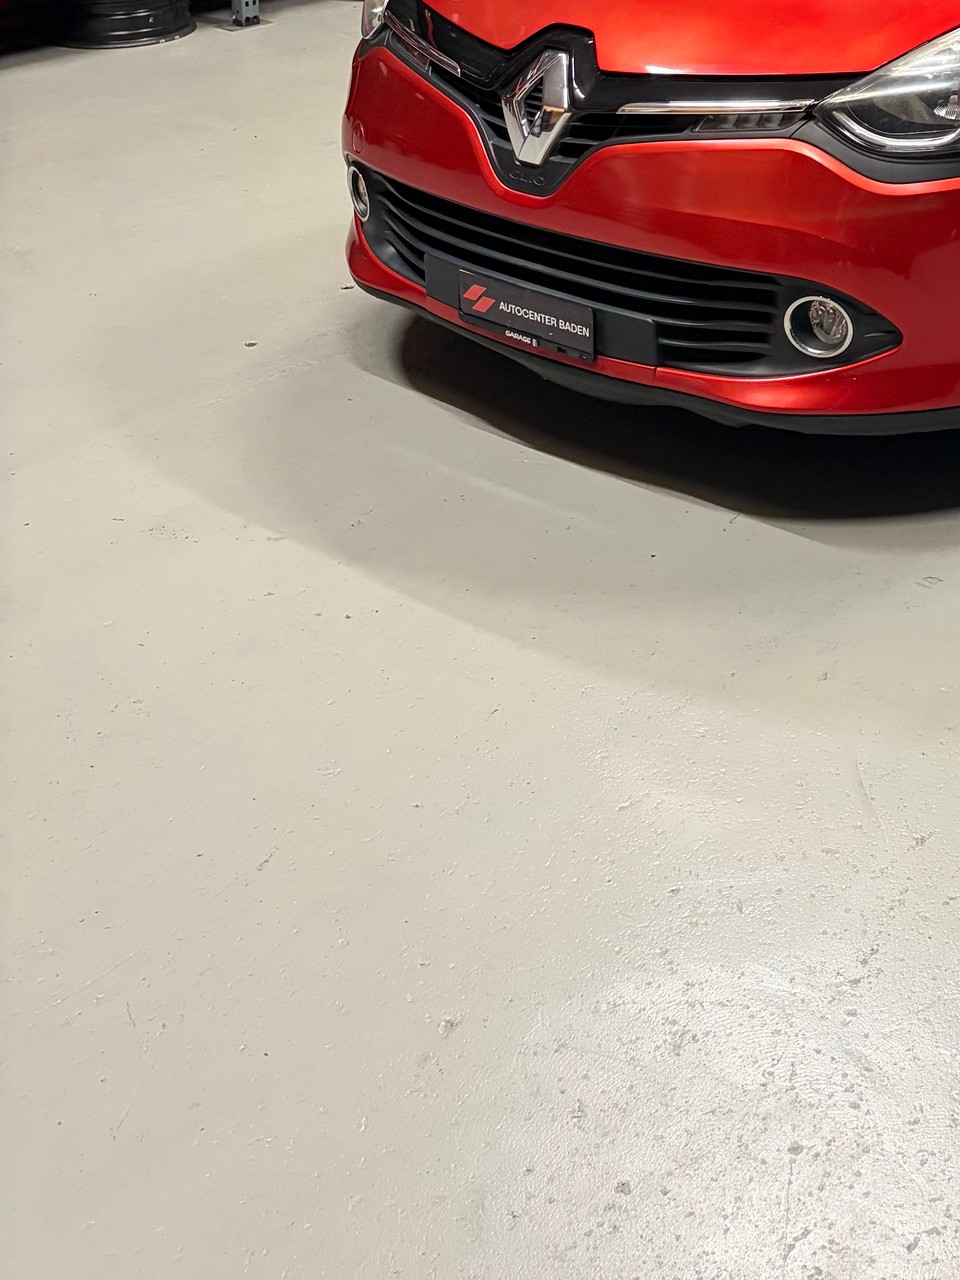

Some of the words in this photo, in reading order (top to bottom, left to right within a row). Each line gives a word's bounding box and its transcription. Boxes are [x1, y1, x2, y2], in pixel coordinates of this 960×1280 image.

[499, 301, 557, 328] AUTOCENTER
[558, 318, 590, 338] BADEN
[504, 330, 531, 345] GARAGE
